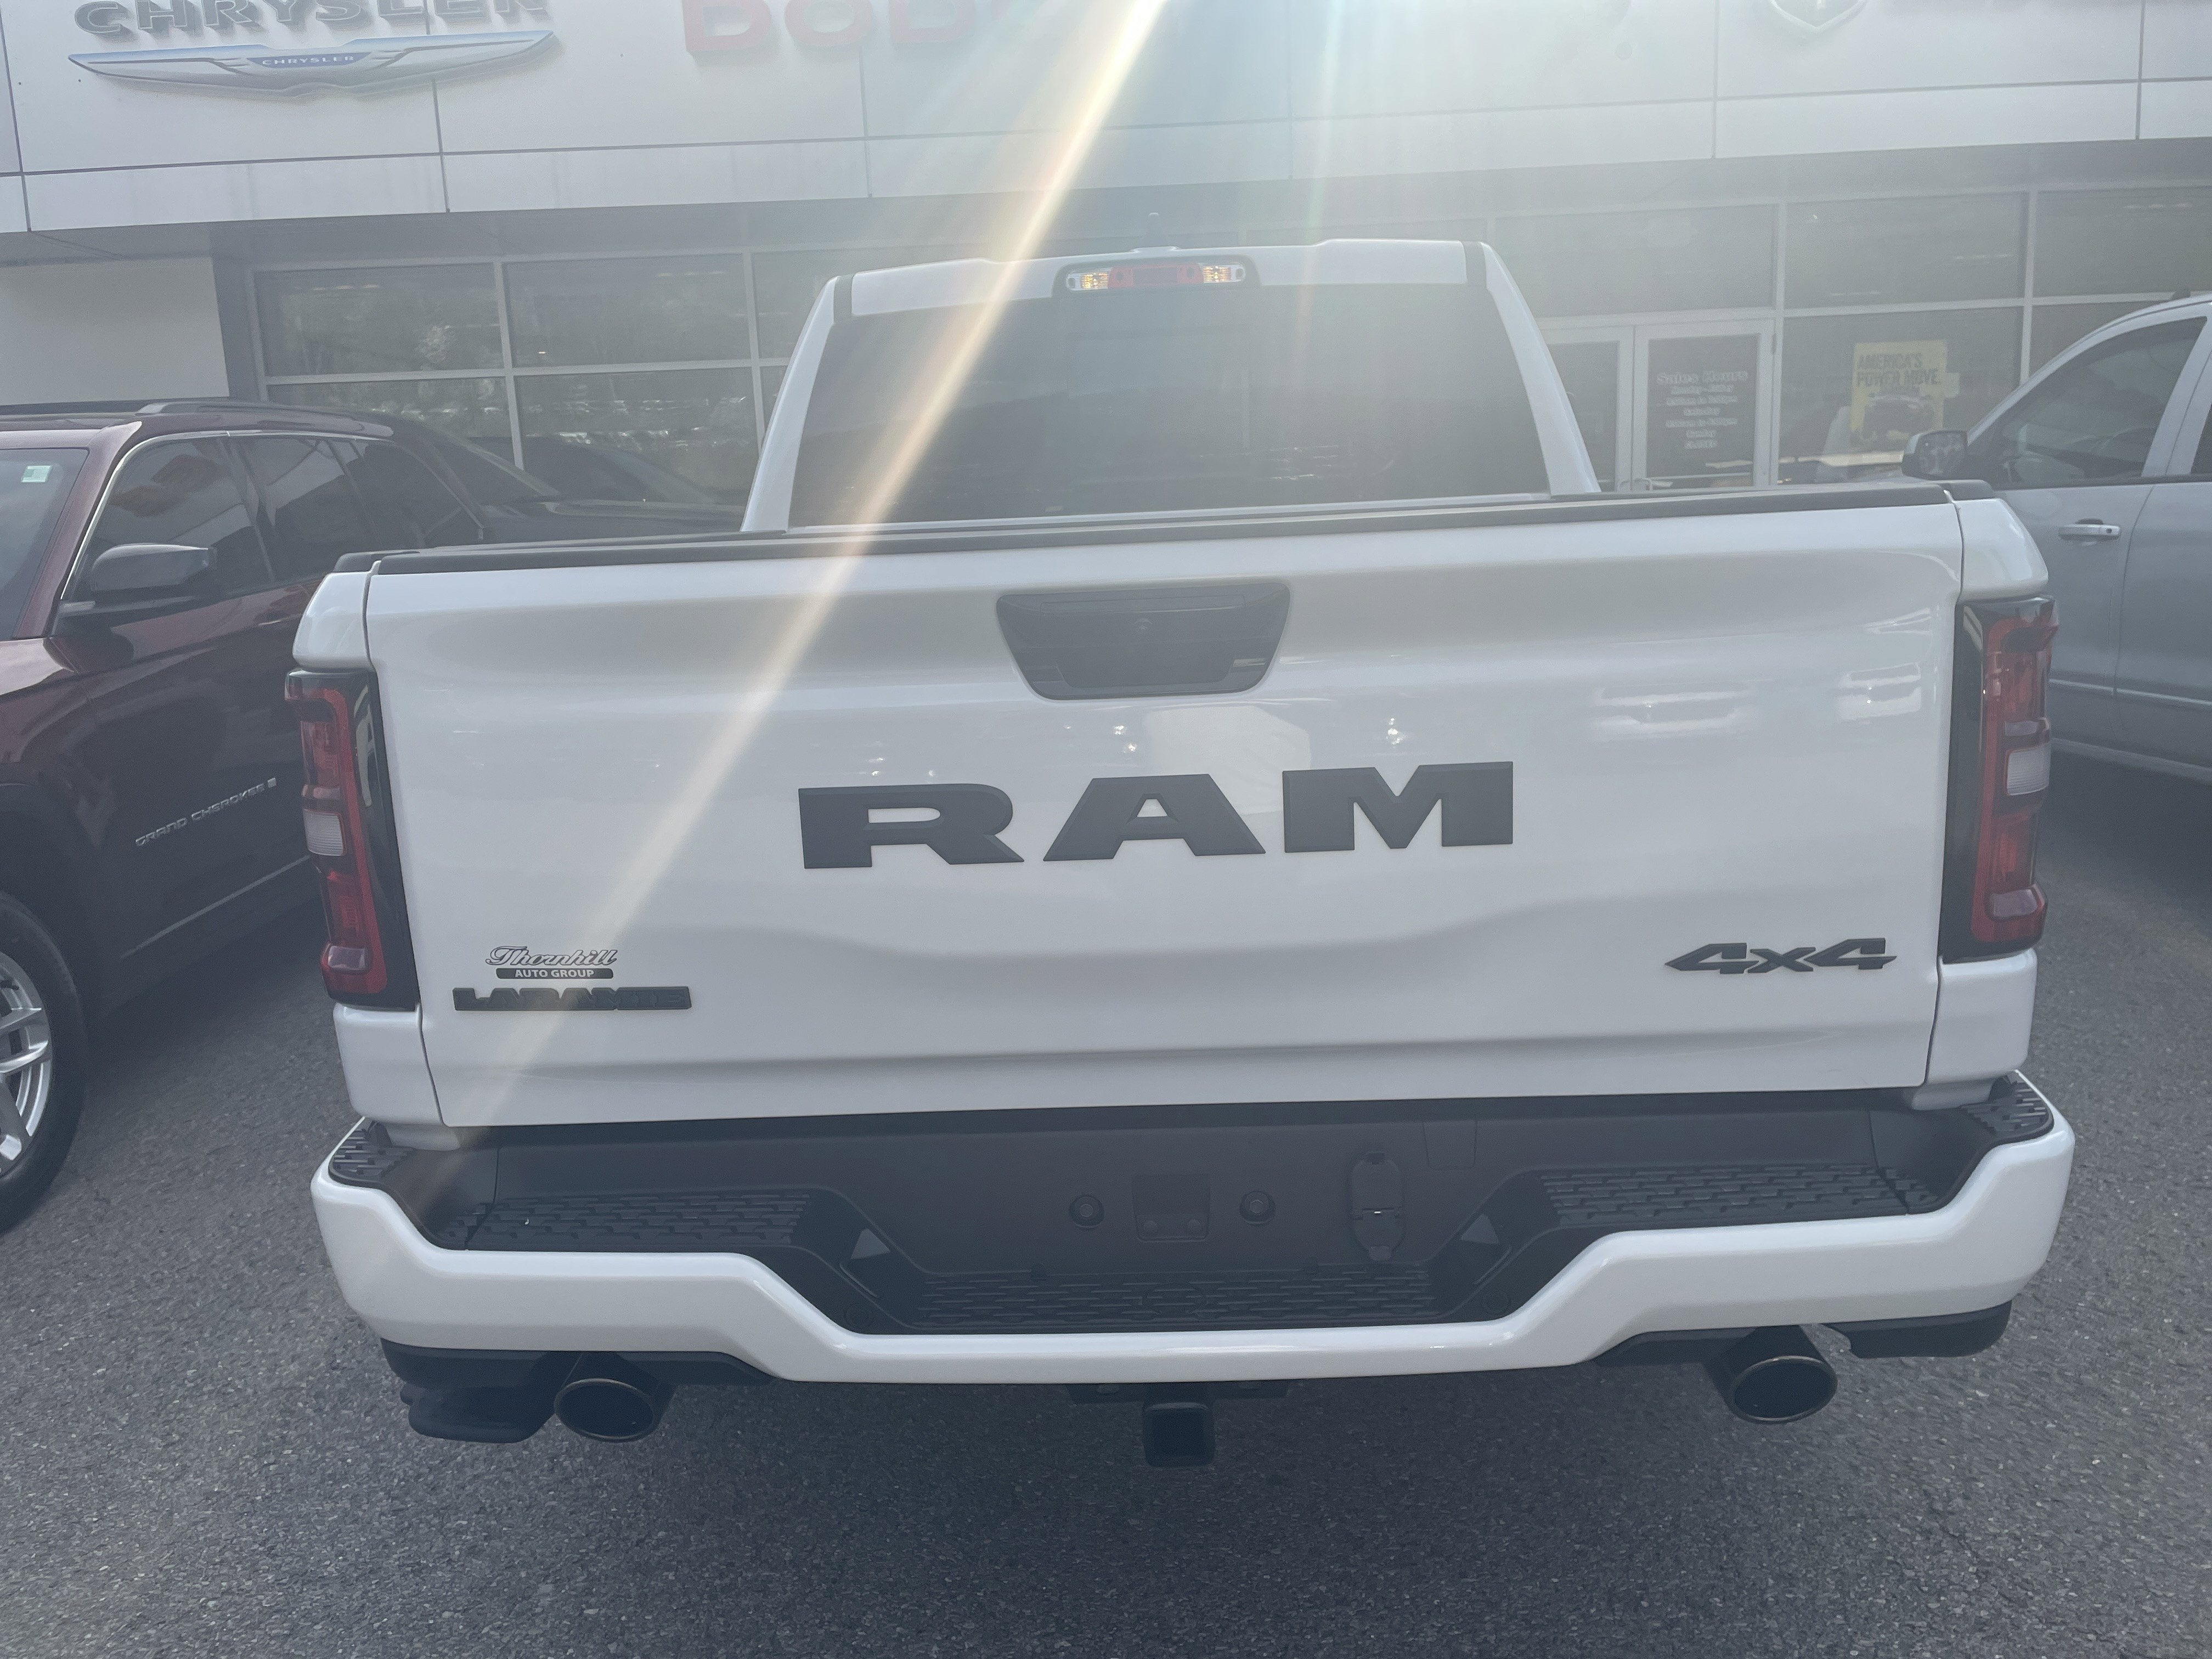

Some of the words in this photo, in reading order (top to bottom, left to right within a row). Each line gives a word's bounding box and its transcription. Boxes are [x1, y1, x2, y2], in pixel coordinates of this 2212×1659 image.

[682, 0, 1007, 53] DOD
[262, 56, 354, 65] CHRYSLER
[136, 817, 187, 847] GRAND
[191, 783, 264, 821] CHEROKEE
[798, 761, 1514, 870] RAM
[485, 945, 618, 967] Thornhill
[515, 969, 548, 978] AUTO
[550, 969, 595, 978] GROUP
[1664, 938, 1897, 974] 4x4
